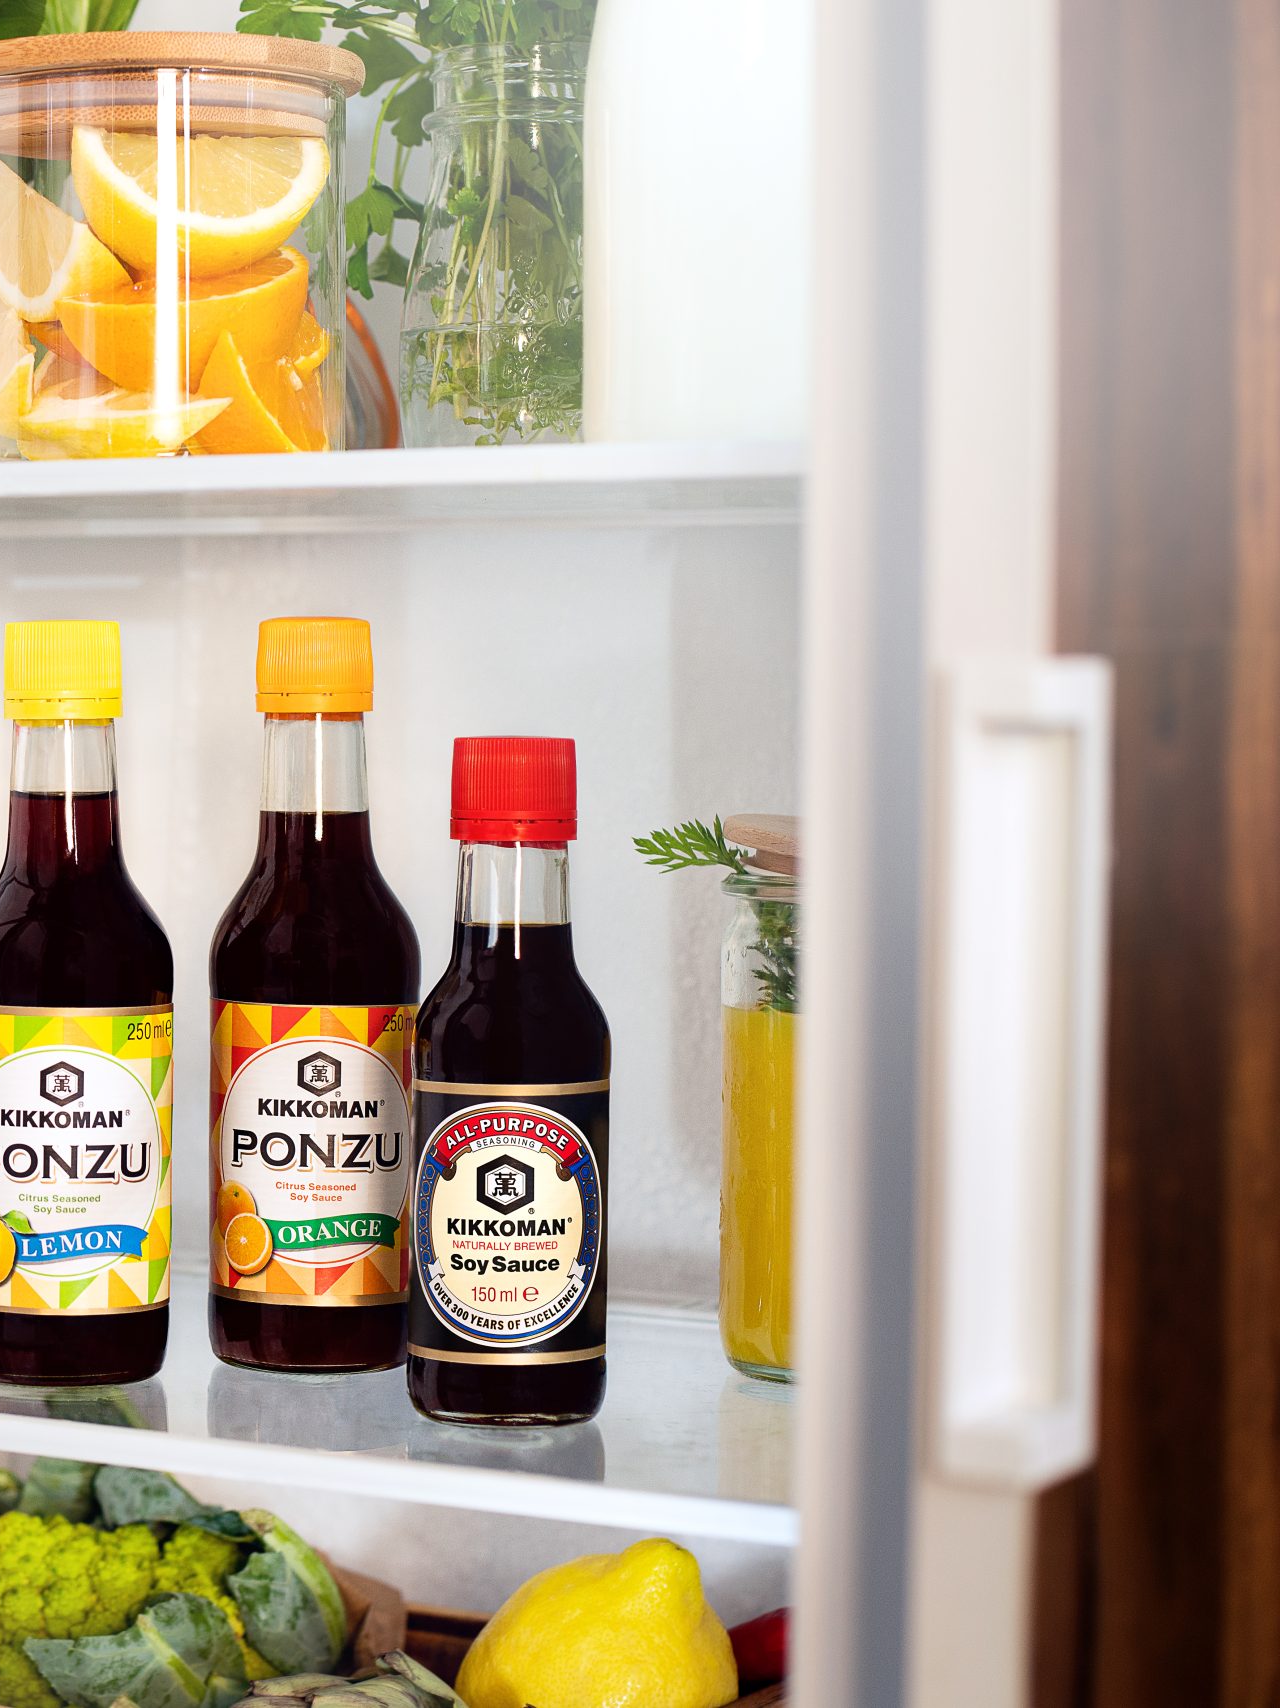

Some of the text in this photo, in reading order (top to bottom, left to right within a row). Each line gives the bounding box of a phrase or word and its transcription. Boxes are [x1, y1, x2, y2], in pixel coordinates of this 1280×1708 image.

[127, 1022, 151, 1040] 250
[383, 1014, 404, 1031] 250
[257, 1098, 378, 1118] KIKKOMAN
[1, 1109, 123, 1128] KIKKOMAN
[445, 1117, 569, 1150] ALL-PURPOSE
[475, 1136, 536, 1148] SEASONING
[231, 1128, 403, 1172] PONZU
[275, 1181, 357, 1192] Citrus Seasoned
[18, 1193, 101, 1203] Citrus Seasoned
[290, 1192, 343, 1203] Soy Sauce
[33, 1205, 87, 1215] Soy Sauce
[277, 1219, 382, 1245] ORANGE
[447, 1218, 566, 1237] KIKKOMAN
[21, 1230, 123, 1259] LEMON
[452, 1240, 558, 1251] NATURALLY BREWED
[450, 1253, 560, 1275] Soy Sauce
[471, 1286, 496, 1302] 150
[500, 1286, 517, 1302] ml
[433, 1282, 579, 1330] OVER 300 YEARS OF EXCELLENCE
